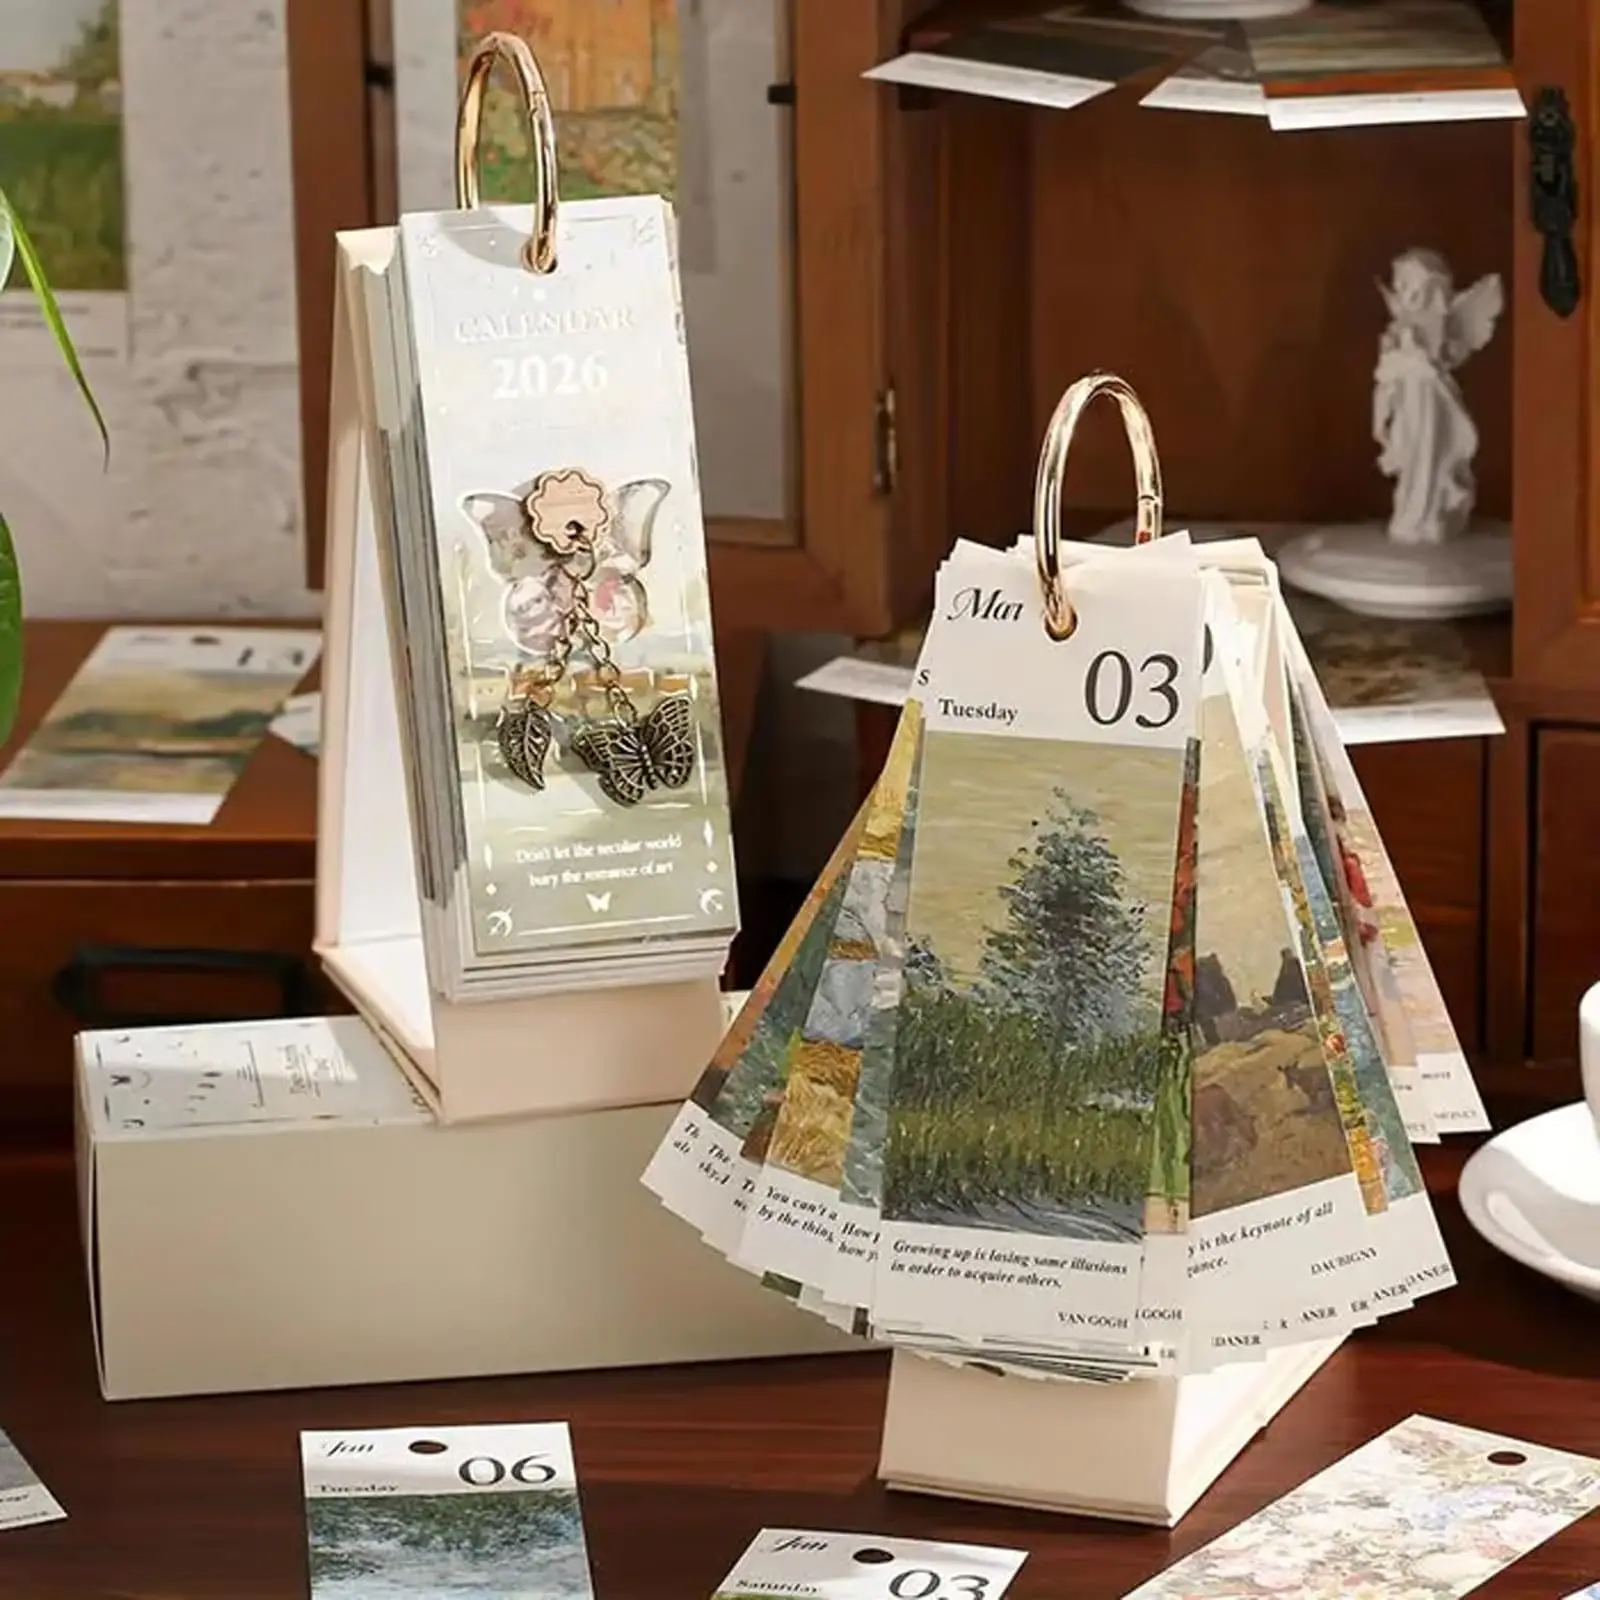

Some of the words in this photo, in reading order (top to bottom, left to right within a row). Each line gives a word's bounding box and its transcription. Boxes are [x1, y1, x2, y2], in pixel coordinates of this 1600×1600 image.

[454, 302, 635, 343] CALENDAR
[491, 351, 609, 400] 2026
[947, 587, 1025, 622] Mar
[1084, 650, 1180, 728] 03
[938, 698, 1019, 726] Tuesday
[573, 843, 594, 858] the
[645, 832, 682, 849] world
[529, 872, 559, 888] bury
[758, 1204, 774, 1221] by
[776, 1212, 799, 1227] the
[766, 1186, 790, 1204] You
[792, 1200, 829, 1216] can't
[1200, 1238, 1212, 1251] is
[1215, 1231, 1237, 1247] the
[1240, 1216, 1292, 1239] keynote
[1295, 1206, 1312, 1225] of
[1315, 1201, 1334, 1218] all
[893, 1239, 951, 1260] Growing
[953, 1248, 971, 1262] up
[974, 1248, 985, 1260] is
[989, 1249, 1030, 1268] losing
[1034, 1256, 1068, 1269] some
[1070, 1256, 1128, 1275] illusions
[1310, 1247, 1378, 1275] DAUBIGNY
[890, 1260, 905, 1272] in
[908, 1262, 945, 1275] order
[948, 1266, 961, 1278] to
[964, 1269, 1014, 1284] acquire
[1057, 1311, 1086, 1325] VAN
[1087, 1315, 1129, 1329] GOGH
[1141, 1308, 1183, 1320] GOGH
[458, 1453, 557, 1486] 06
[313, 1483, 399, 1493] Tuesday
[888, 1568, 990, 1600] 03
